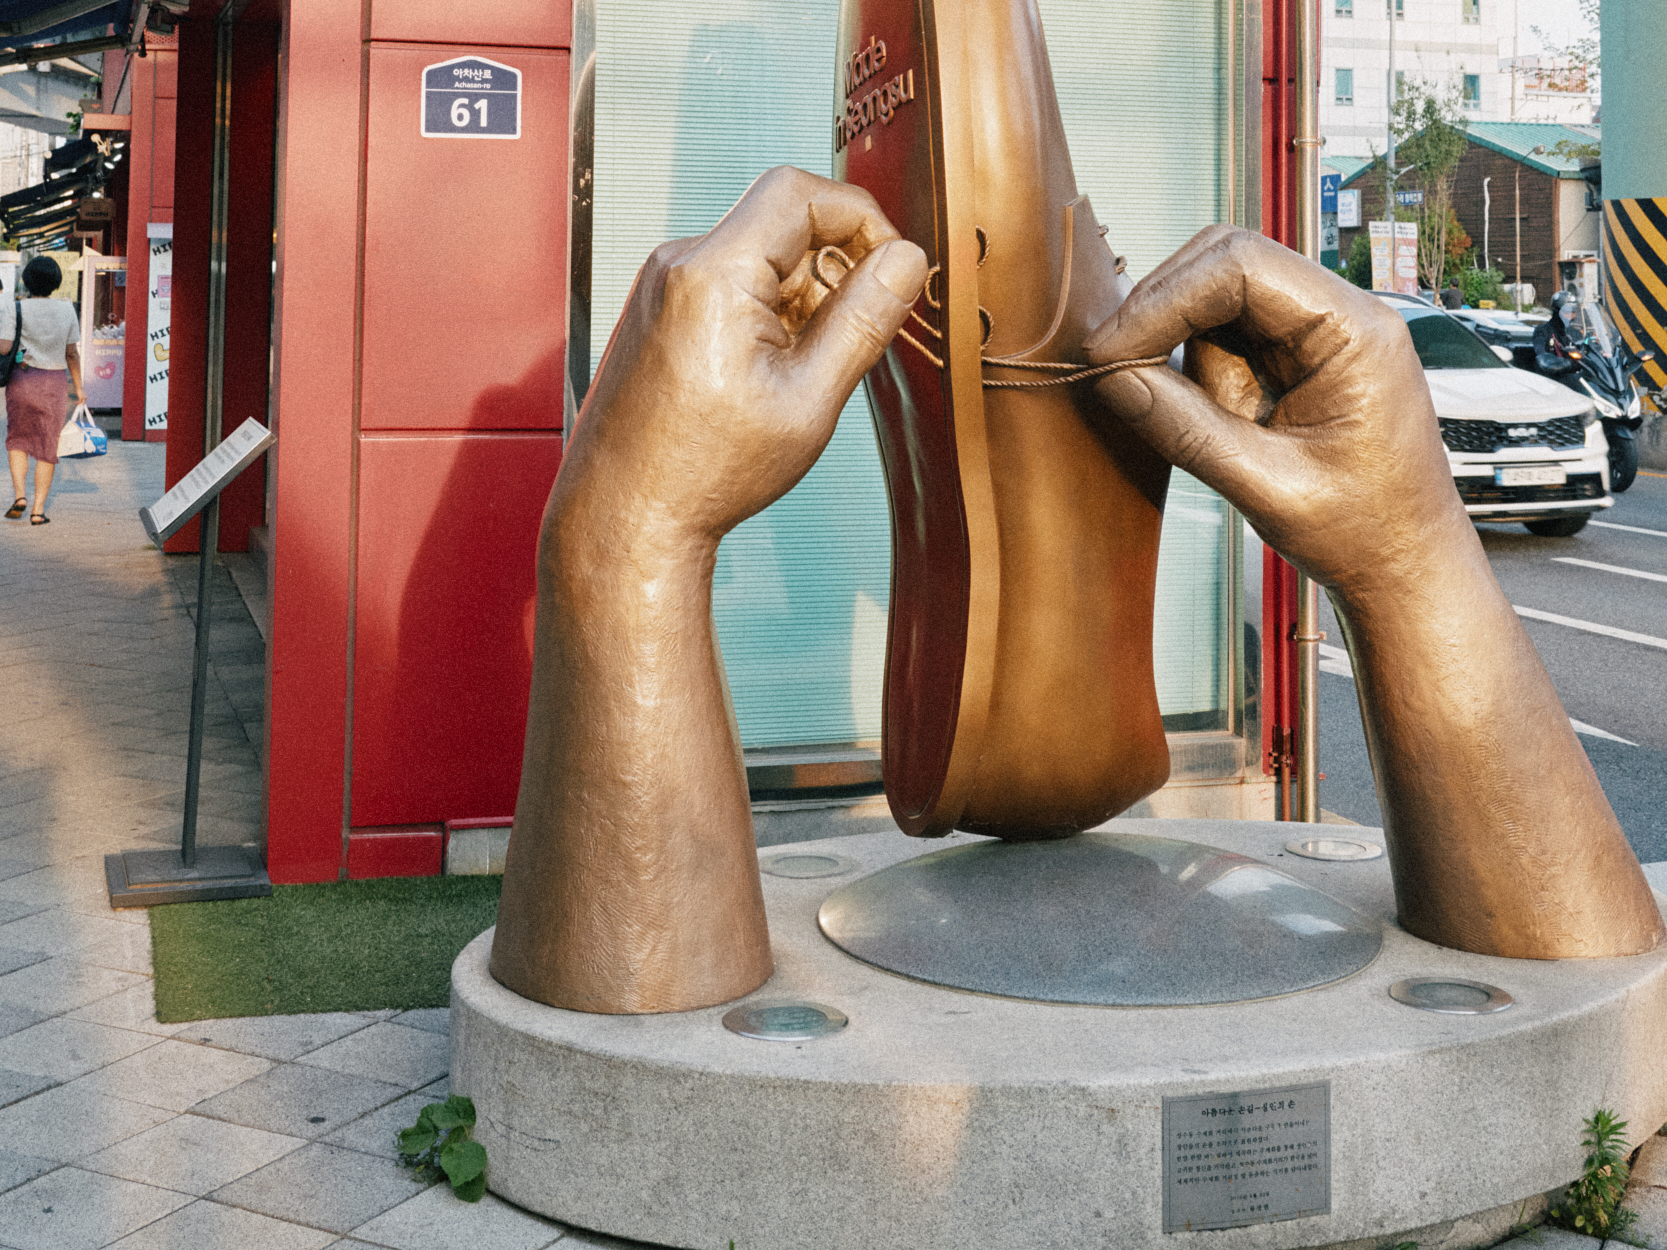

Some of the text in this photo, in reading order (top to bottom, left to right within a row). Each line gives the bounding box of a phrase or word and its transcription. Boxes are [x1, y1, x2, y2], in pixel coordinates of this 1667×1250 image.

[453, 68, 493, 81] 아차산로
[454, 81, 491, 89] Achasan-ro
[450, 97, 488, 128] 61
